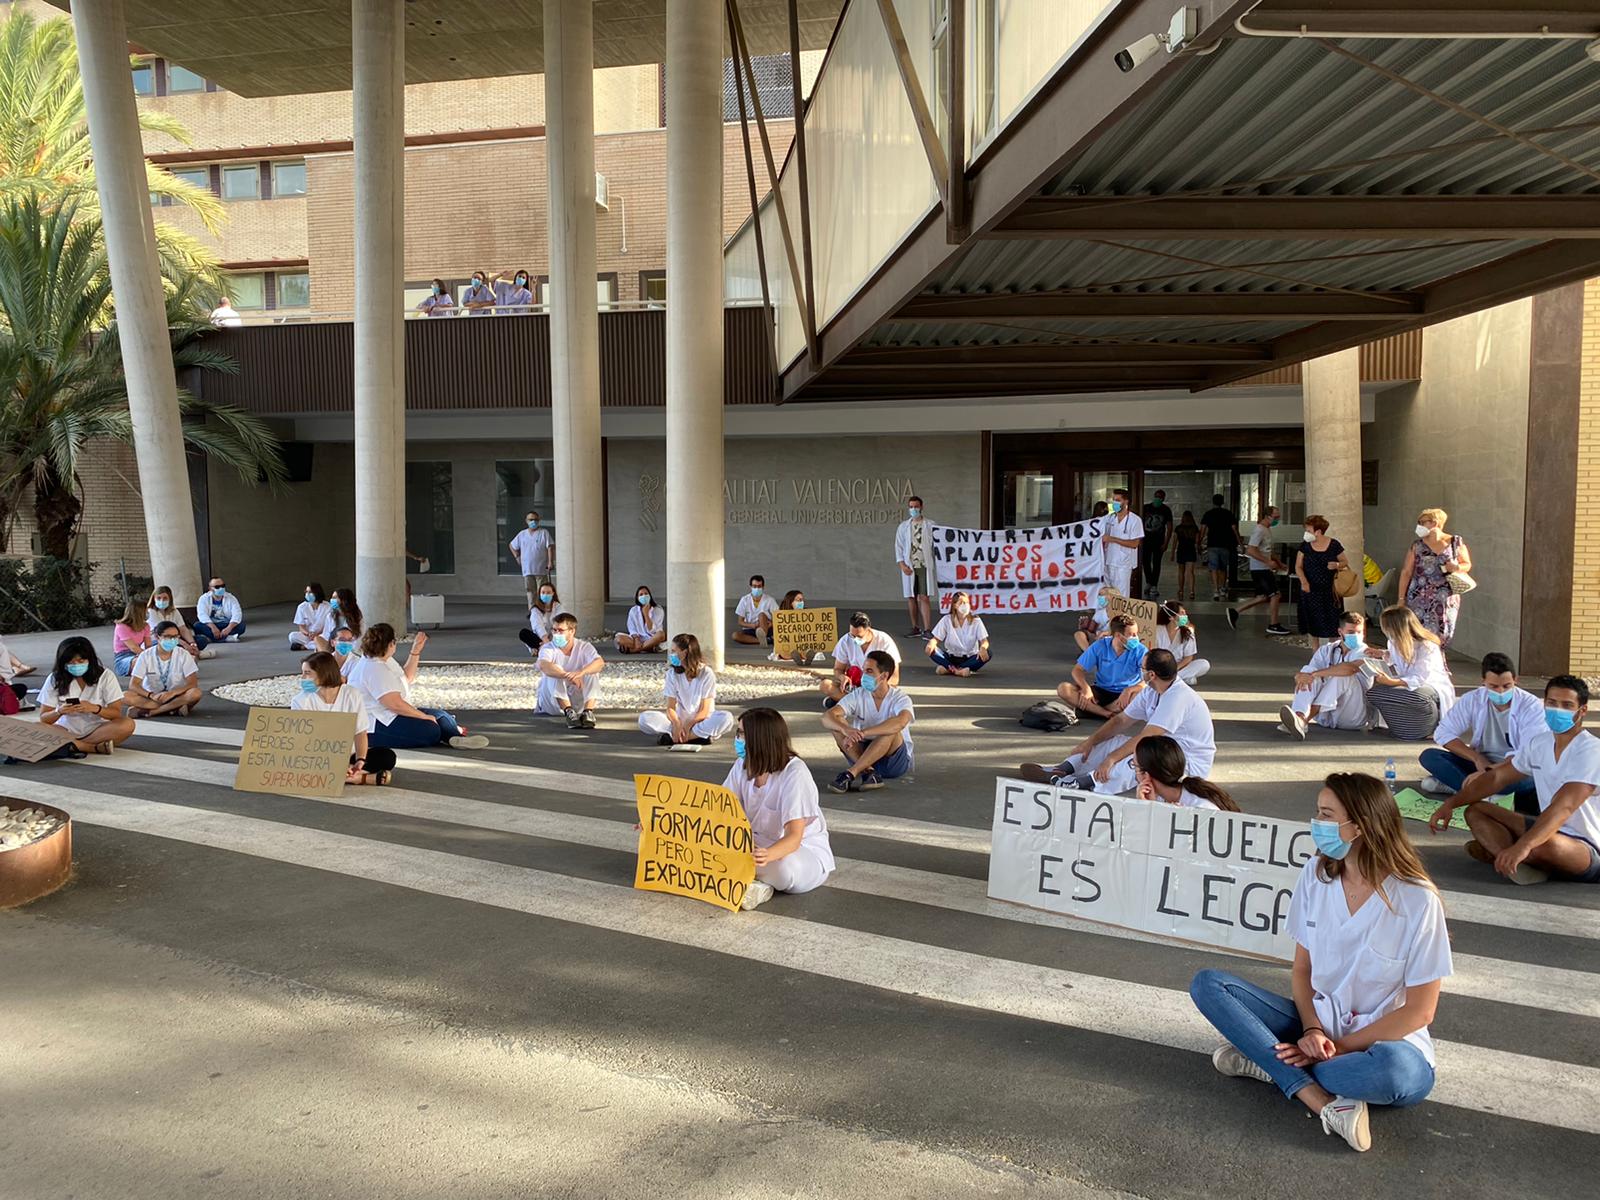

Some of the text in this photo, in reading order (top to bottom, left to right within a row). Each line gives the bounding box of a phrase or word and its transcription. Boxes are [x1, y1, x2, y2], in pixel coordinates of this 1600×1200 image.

[792, 479, 914, 504] VALENCIANA
[729, 510, 787, 524] GENERAL
[790, 510, 877, 524] UNIVERSITARI
[932, 519, 1101, 543] CONVIRTAMOS
[934, 541, 1093, 563] APLAUSOS EN
[956, 559, 1076, 580] DERECHOS
[941, 590, 1088, 610] #UELGA MIR
[777, 612, 833, 624] SUELDO DE
[777, 623, 833, 633] BECARIO PERO
[796, 642, 826, 652] HORARIO
[823, 633, 832, 641] DE
[254, 715, 314, 734] SI SOMOS
[282, 755, 330, 771] NUESTRA
[642, 777, 672, 803] LO
[1003, 786, 1312, 868] ESTA HUELG
[656, 837, 728, 873] PERO ES
[644, 860, 747, 906] EXPLOTACIO
[1038, 855, 1293, 935] ES LEGA
